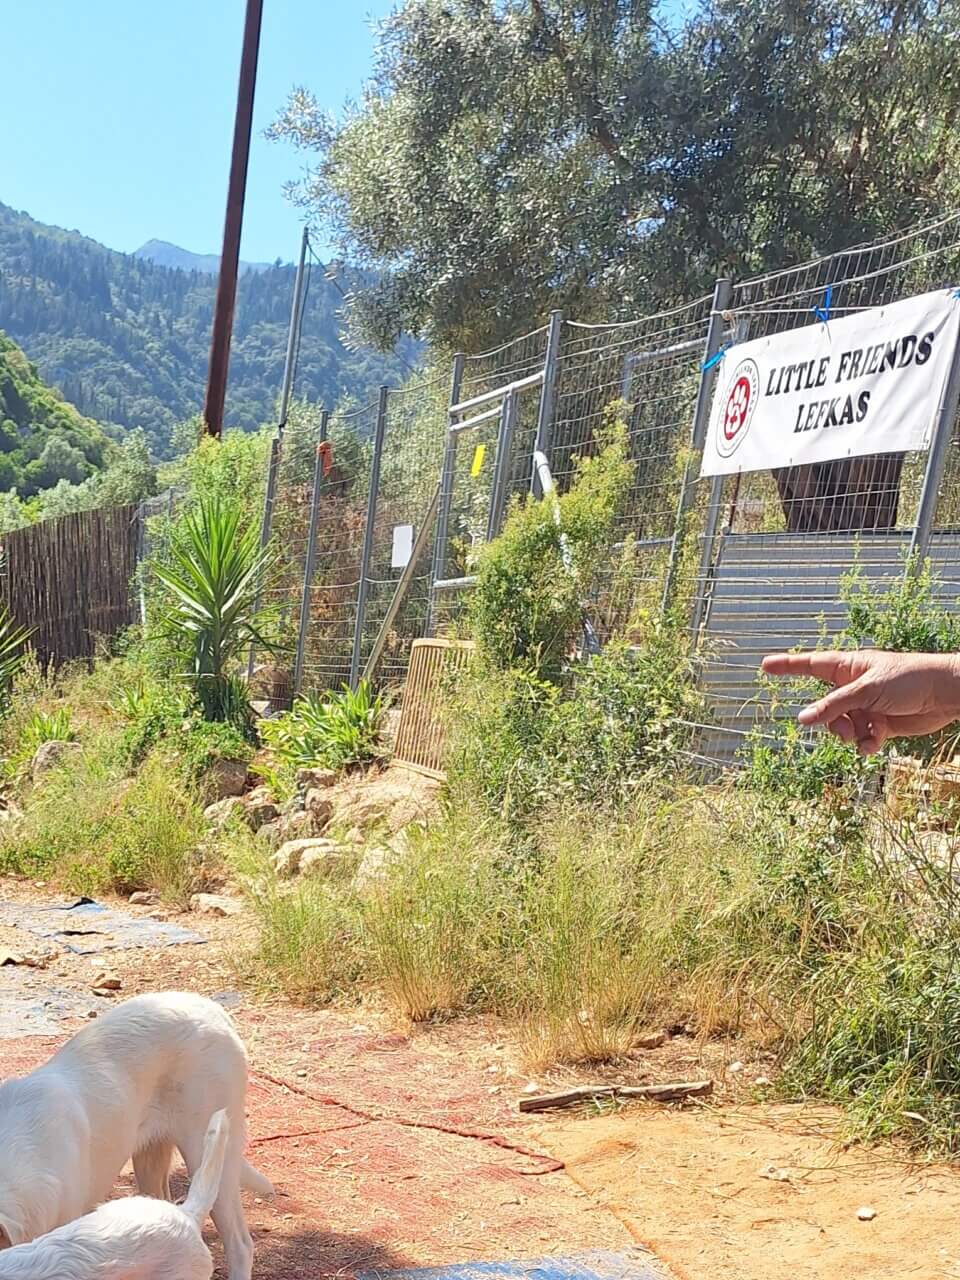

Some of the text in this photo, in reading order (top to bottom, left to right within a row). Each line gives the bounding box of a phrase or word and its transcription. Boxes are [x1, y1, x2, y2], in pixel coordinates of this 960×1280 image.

[765, 356, 830, 397] LITTLE
[835, 331, 935, 384] FRIENDS
[793, 391, 871, 433] LEFKAS
